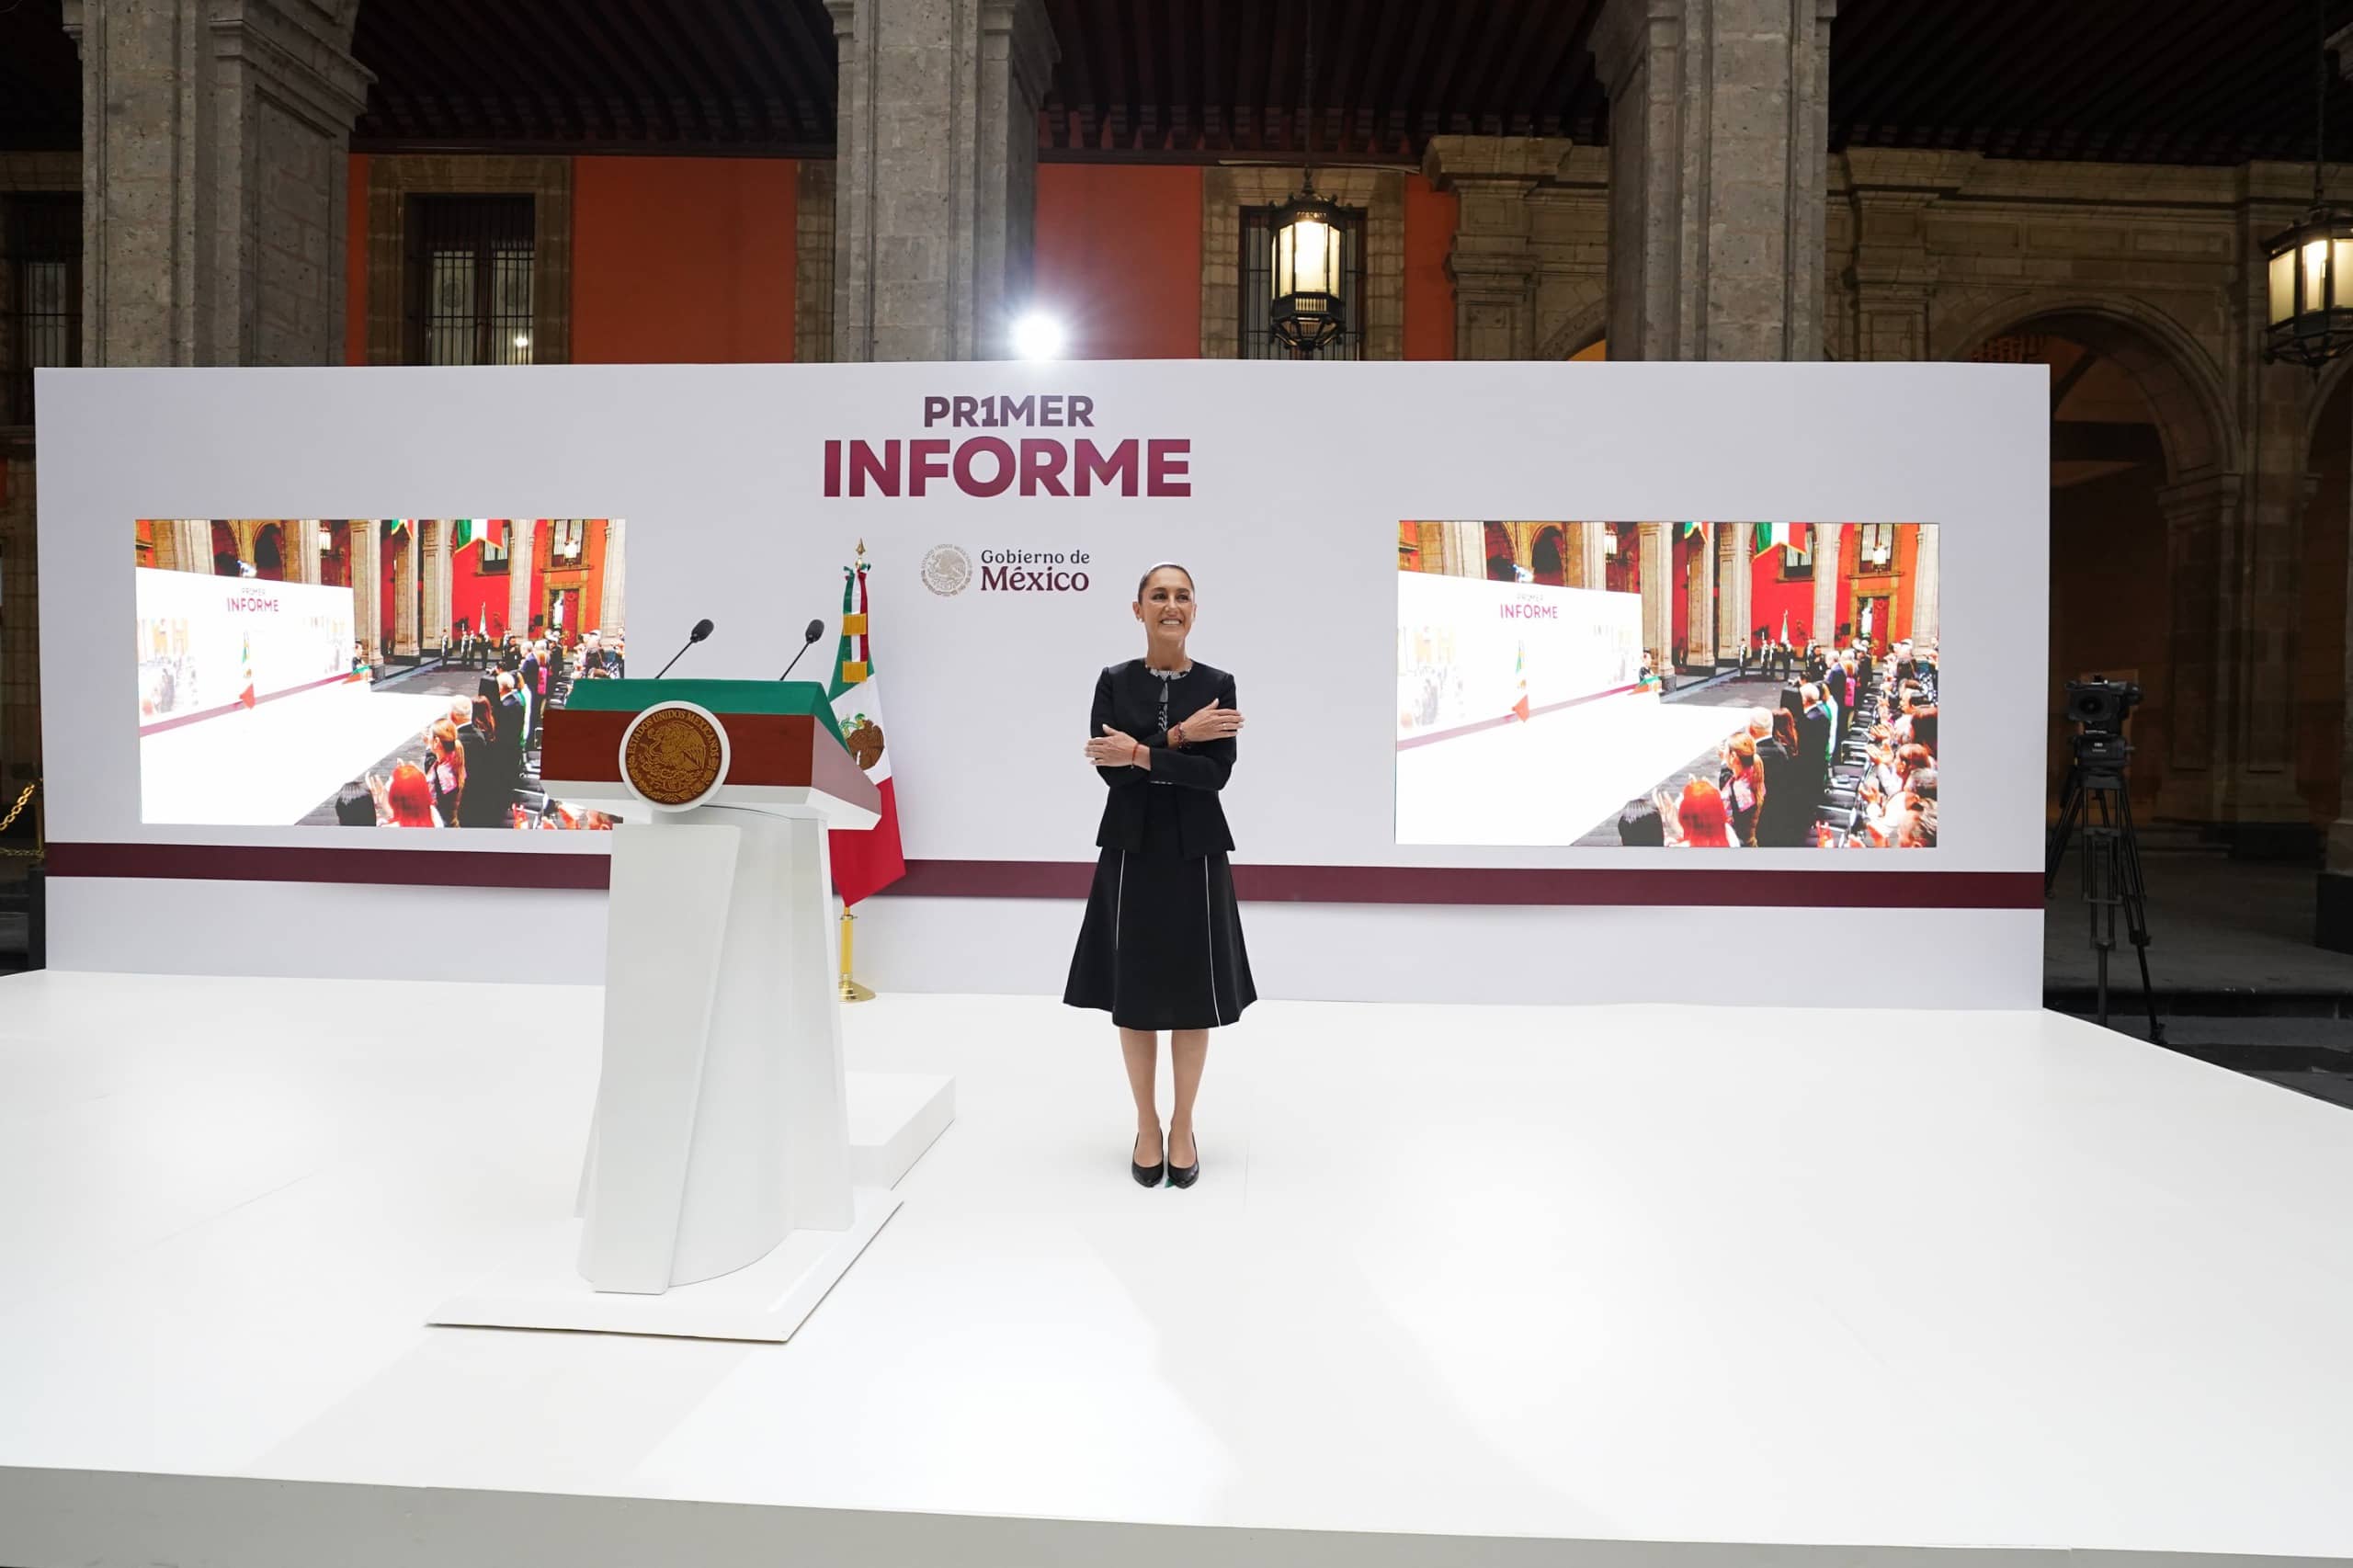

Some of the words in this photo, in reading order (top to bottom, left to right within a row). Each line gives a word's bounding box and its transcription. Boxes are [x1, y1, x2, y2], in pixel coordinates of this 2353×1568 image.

[924, 395, 1095, 427] PR1MER
[824, 436, 1191, 497] INFORME
[981, 550, 1064, 564] Gobierno
[1070, 550, 1090, 564] de
[981, 566, 1089, 591] México
[227, 597, 278, 612] INFORME
[1500, 603, 1559, 619] INFORME
[627, 718, 653, 754] ESTADOS
[653, 710, 686, 722] UNIDOS
[686, 711, 720, 757] MEXICANOS
